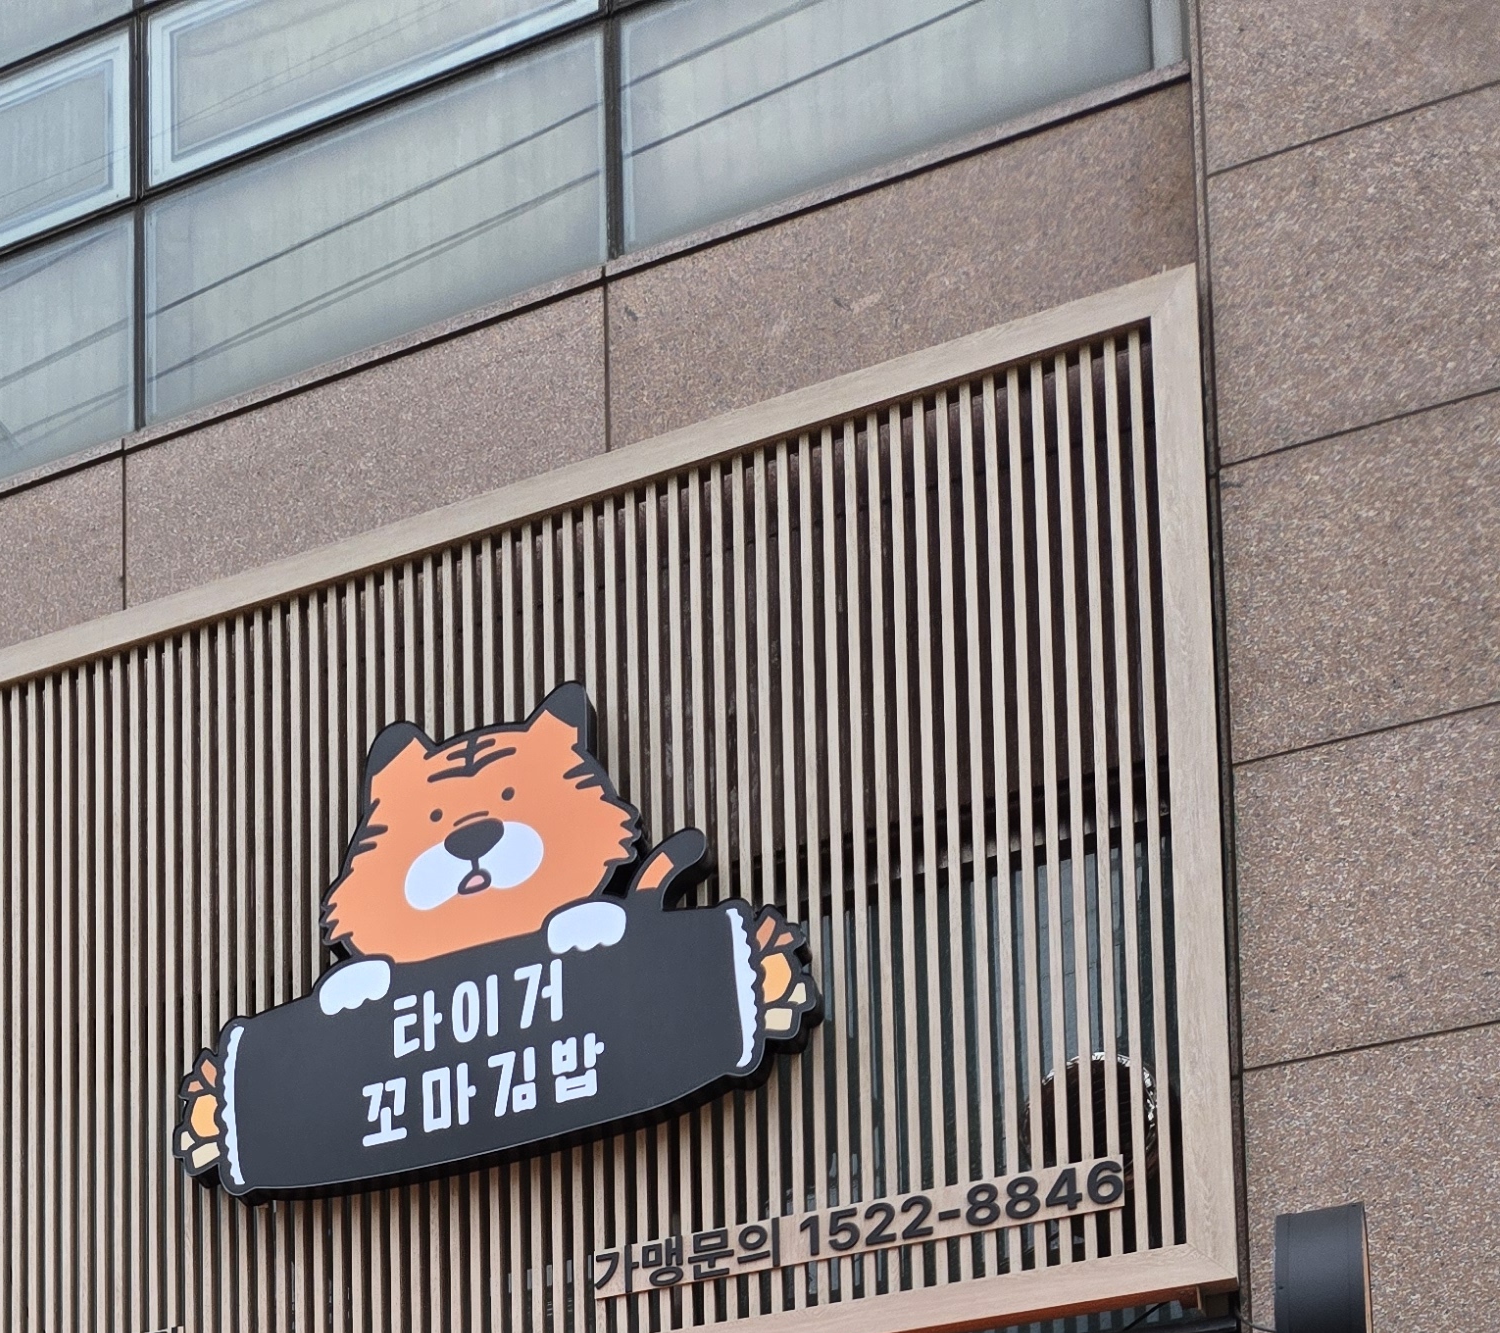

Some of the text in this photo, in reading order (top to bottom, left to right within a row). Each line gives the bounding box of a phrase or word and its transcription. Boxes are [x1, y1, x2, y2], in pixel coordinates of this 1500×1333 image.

[392, 959, 564, 1059] 타이거
[361, 1030, 606, 1149] 꼬마김밥
[594, 1158, 1125, 1297] 가맹문의 1522-8846
